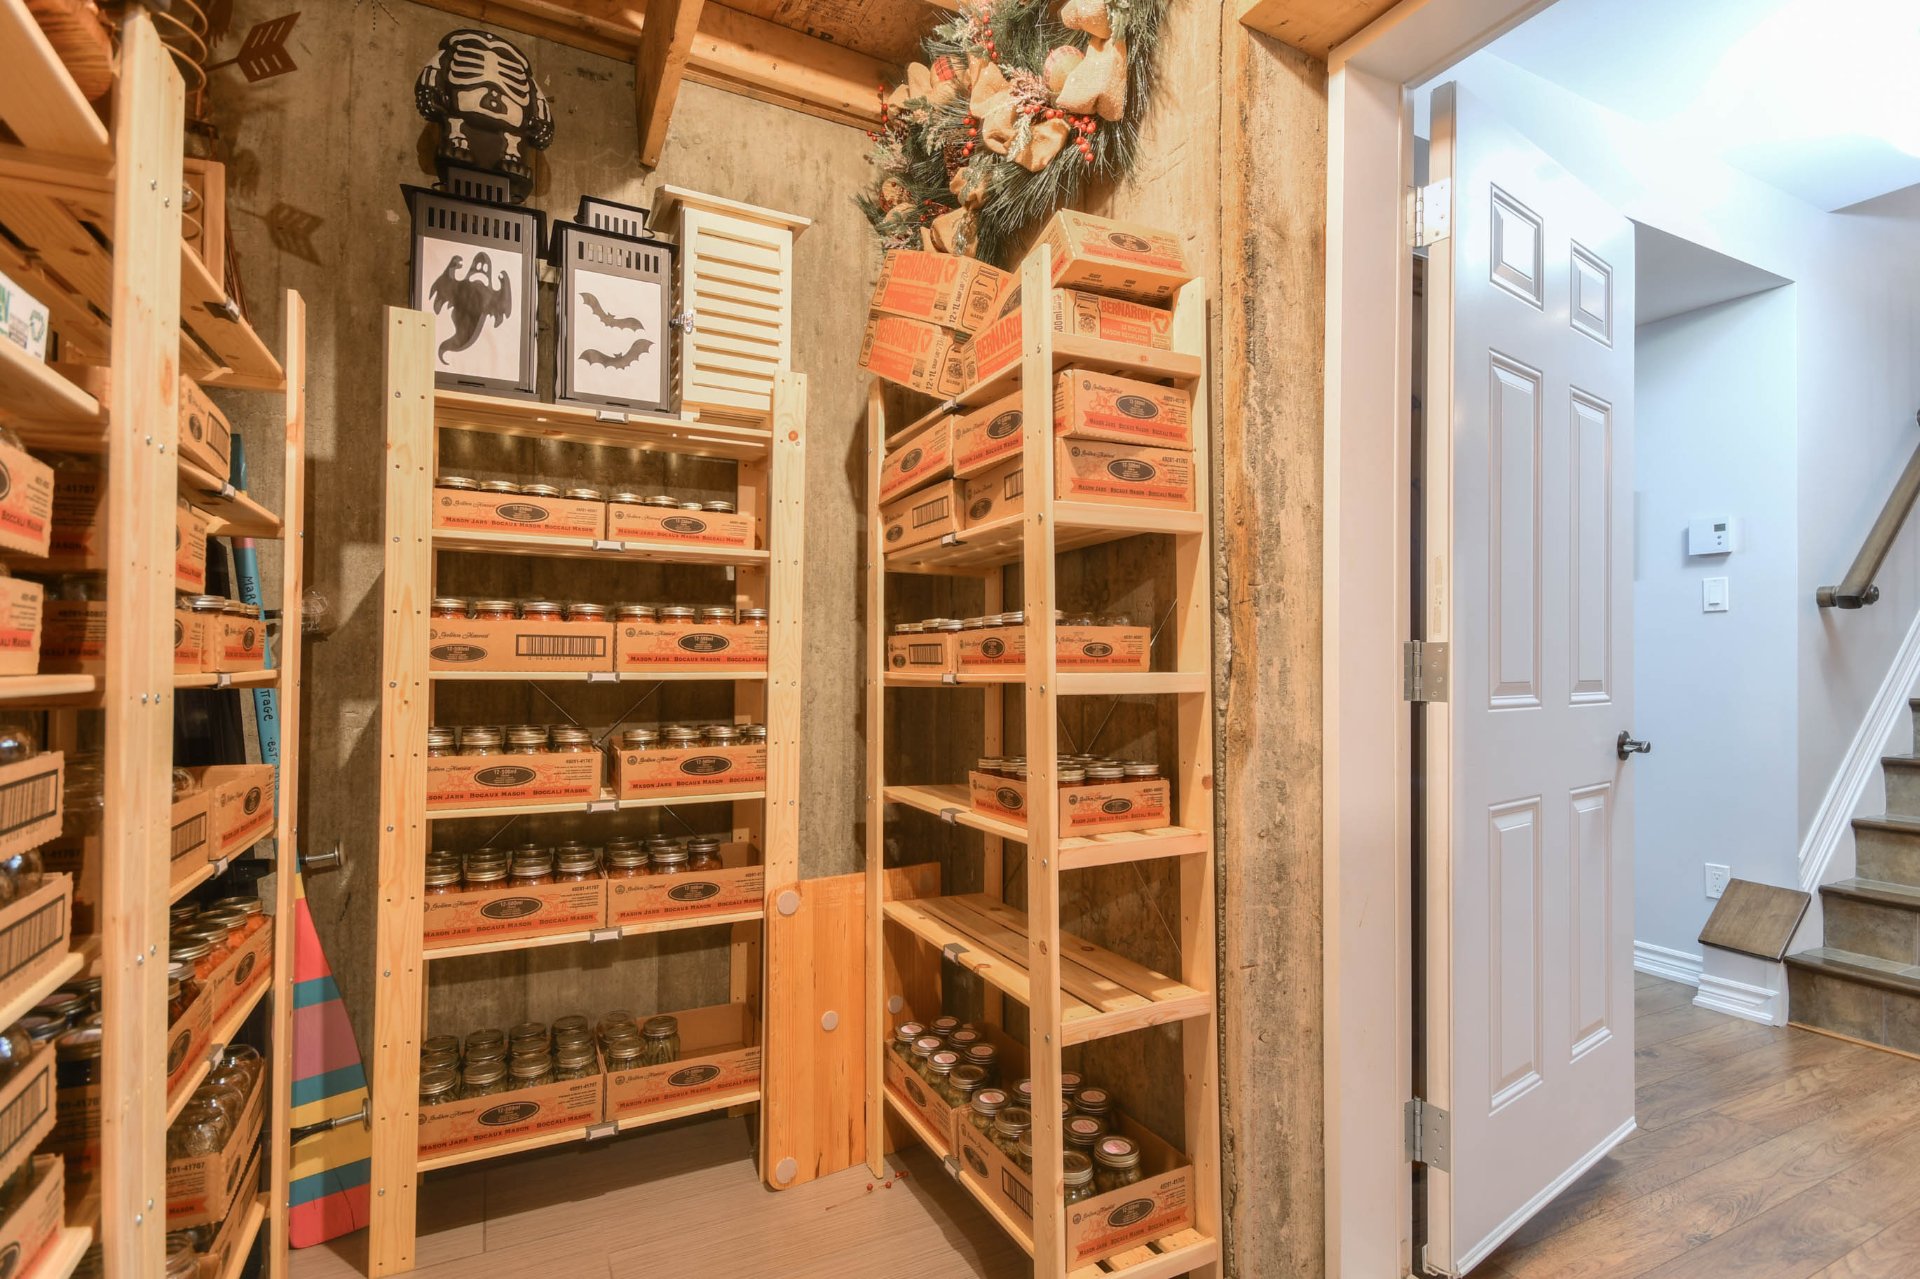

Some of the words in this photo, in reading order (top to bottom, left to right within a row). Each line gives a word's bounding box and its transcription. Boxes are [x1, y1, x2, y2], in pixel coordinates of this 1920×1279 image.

[1101, 300, 1153, 322] BERNARDIN
[476, 924, 505, 932] BOCAUX
[539, 917, 569, 925] BOCCALI
